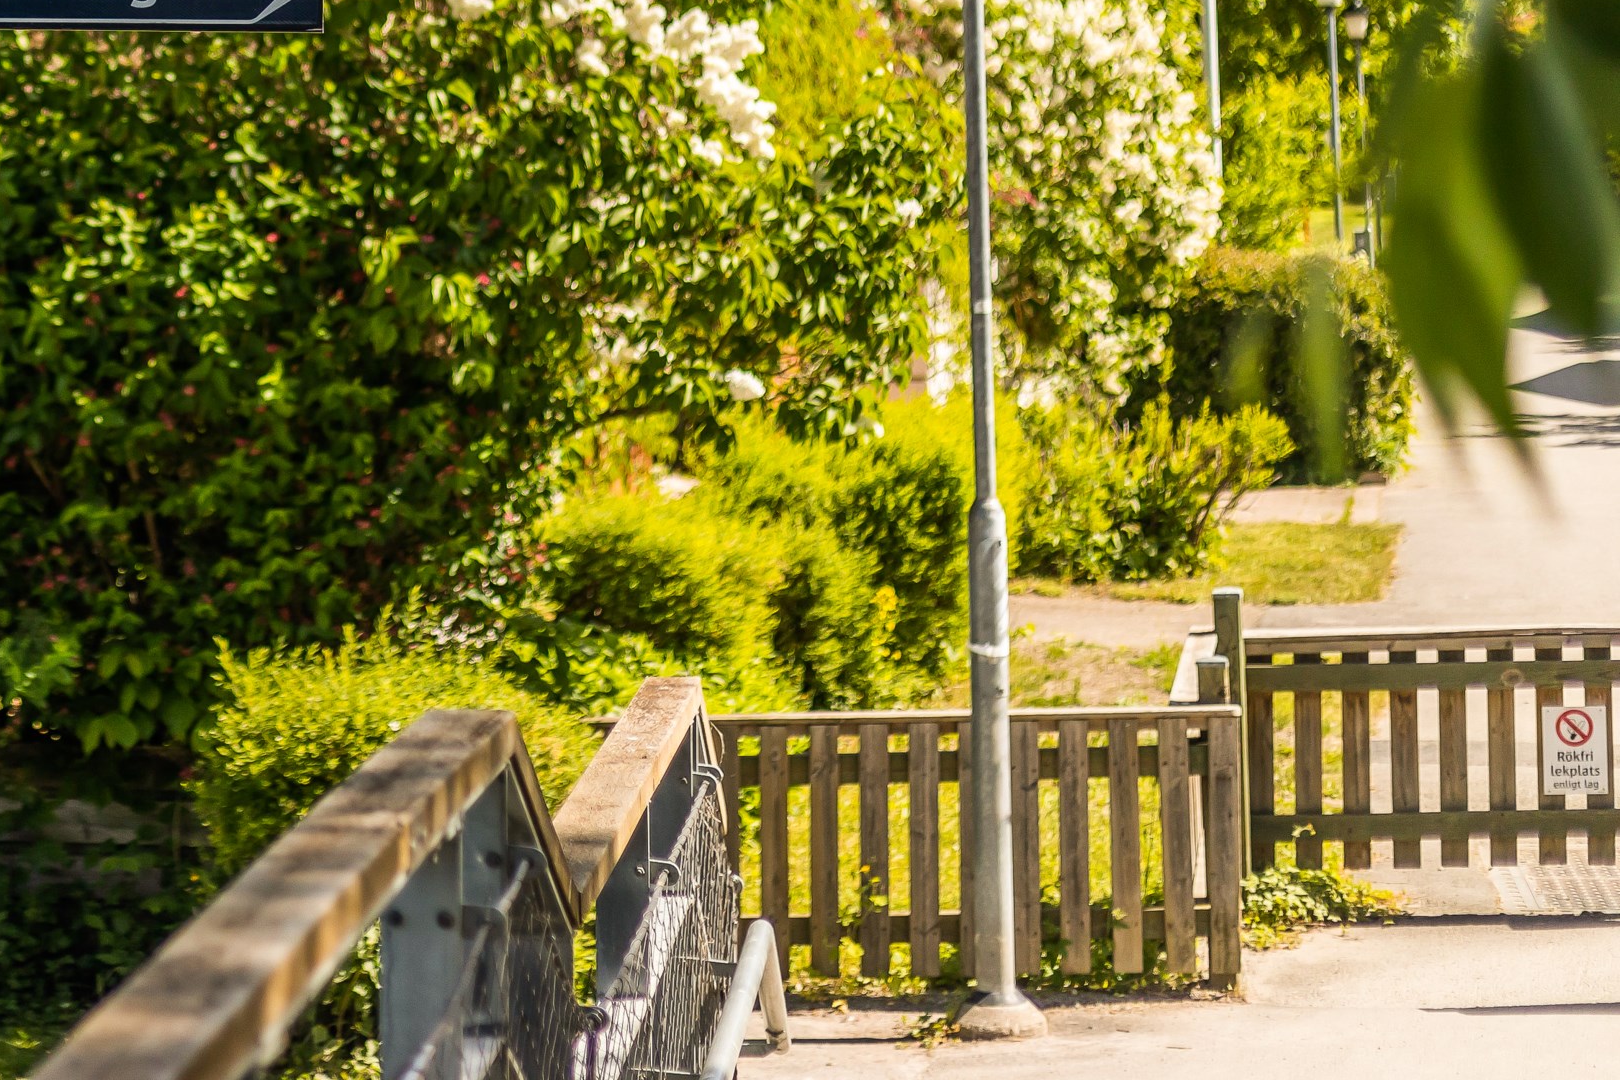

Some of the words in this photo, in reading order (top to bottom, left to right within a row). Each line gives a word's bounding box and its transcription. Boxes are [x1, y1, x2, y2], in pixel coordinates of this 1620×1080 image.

[1557, 751, 1593, 762] Rökfri
[1550, 765, 1600, 778] lekplats
[1553, 780, 1581, 791] enligt
[1584, 780, 1599, 791] lag
